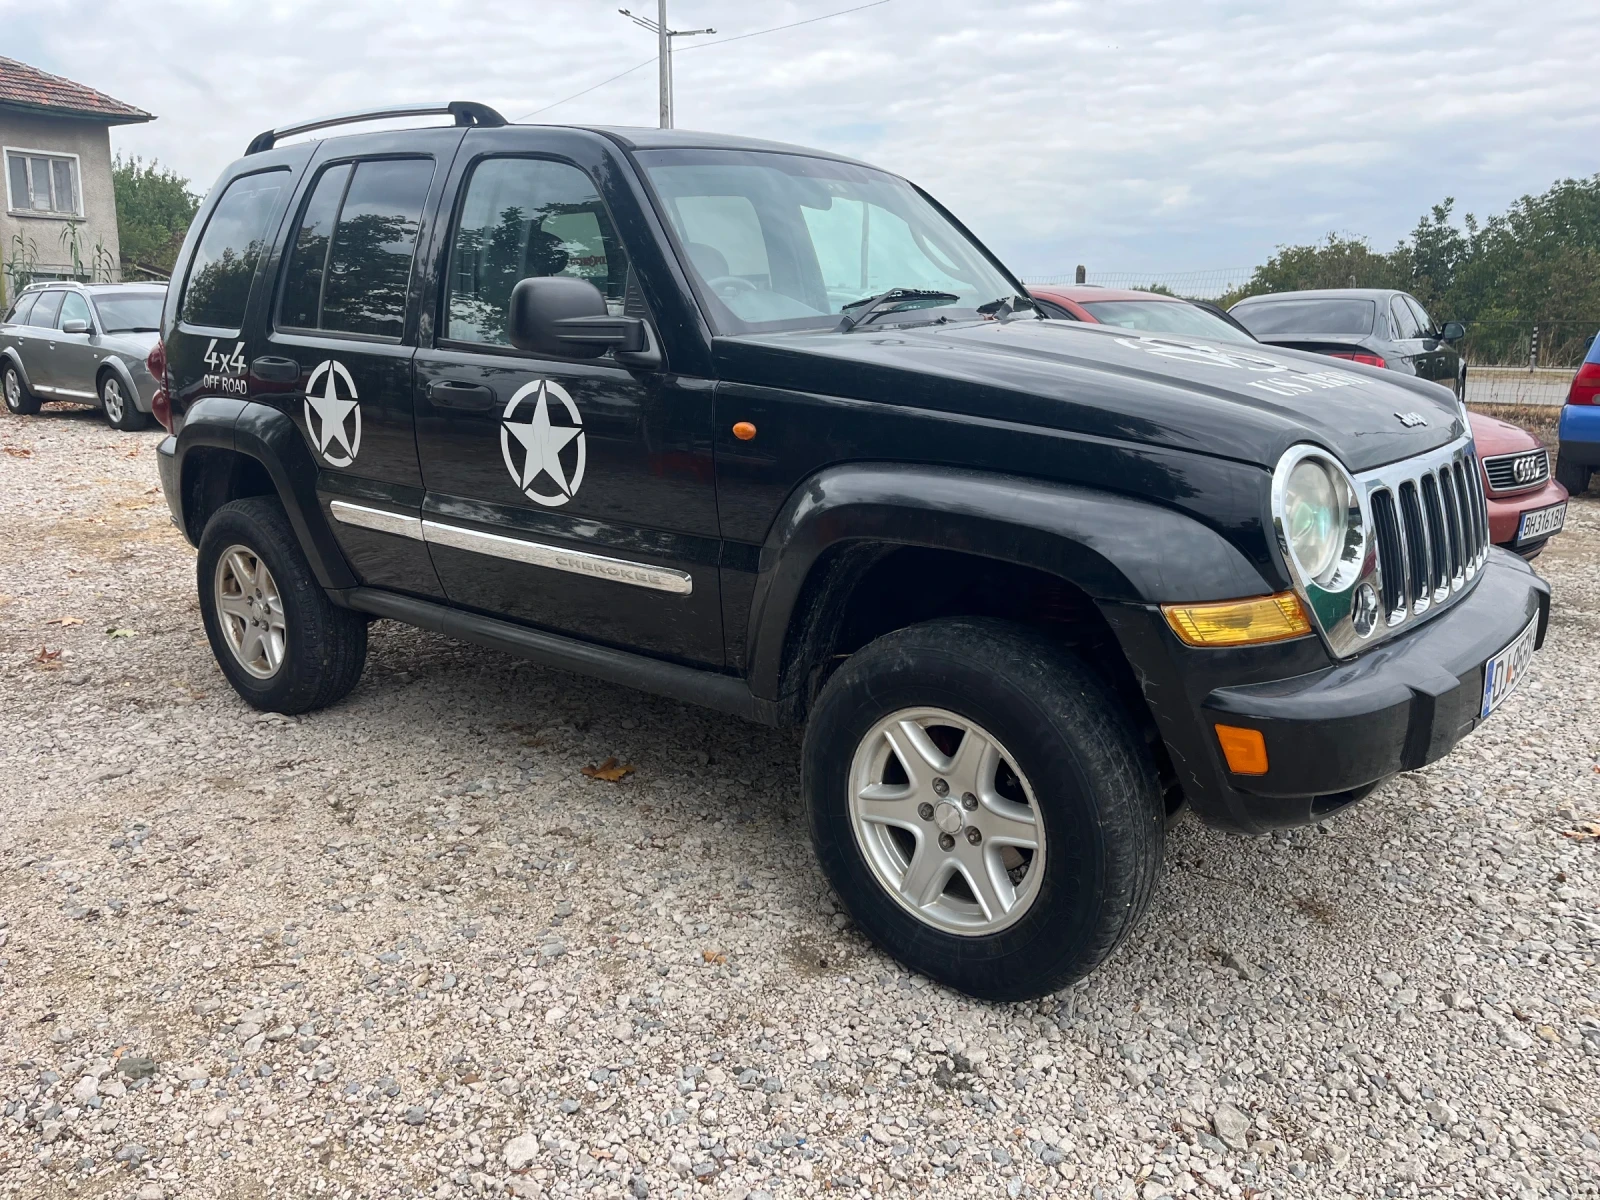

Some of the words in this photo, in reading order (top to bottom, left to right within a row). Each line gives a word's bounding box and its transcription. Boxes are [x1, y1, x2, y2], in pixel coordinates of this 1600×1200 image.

[203, 374, 220, 389] OFF
[222, 377, 247, 395] ROAD
[1246, 377, 1313, 397] US
[556, 556, 661, 584] CHEROKEE
